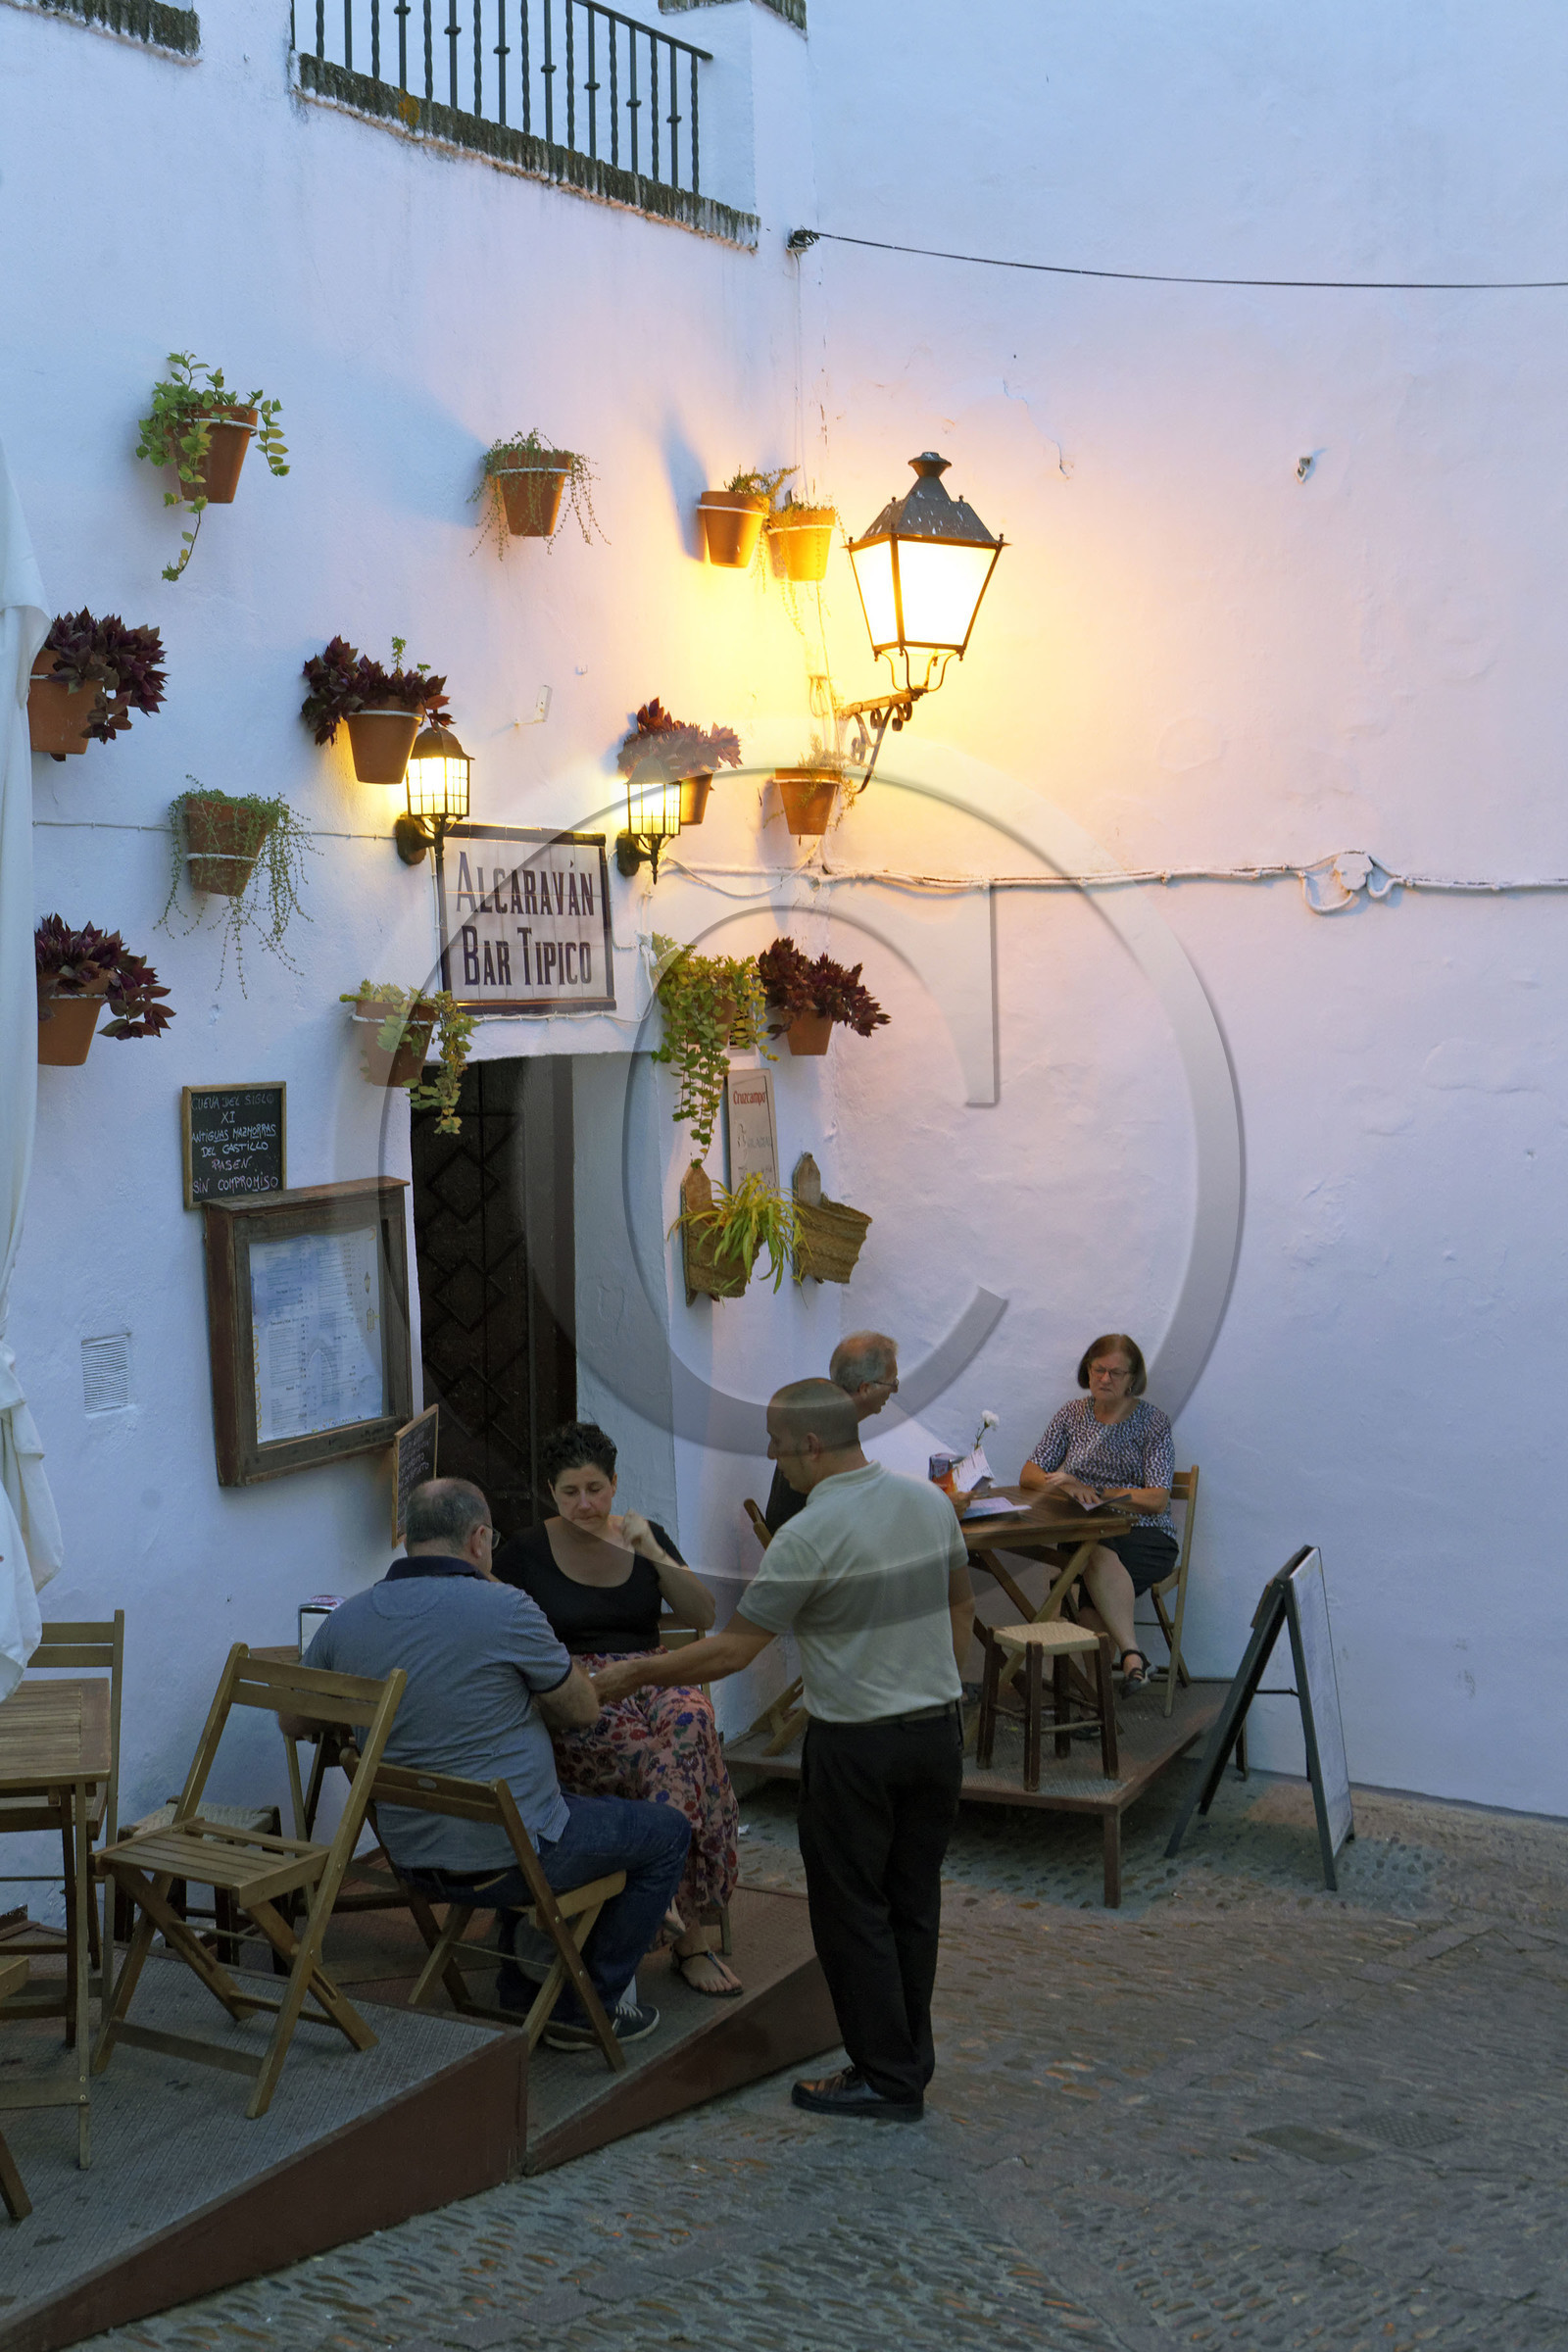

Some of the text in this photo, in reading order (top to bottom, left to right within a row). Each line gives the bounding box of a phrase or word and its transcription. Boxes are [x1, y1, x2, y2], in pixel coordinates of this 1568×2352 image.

[456, 851, 594, 915] ALCARAVÁN
[462, 925, 592, 986] BAR TIPICO
[221, 1097, 240, 1107] DEL
[244, 1093, 274, 1105] SIGLO
[733, 1091, 766, 1105] Cruzcampo
[220, 1110, 235, 1124] XI
[201, 1147, 217, 1157] DEL
